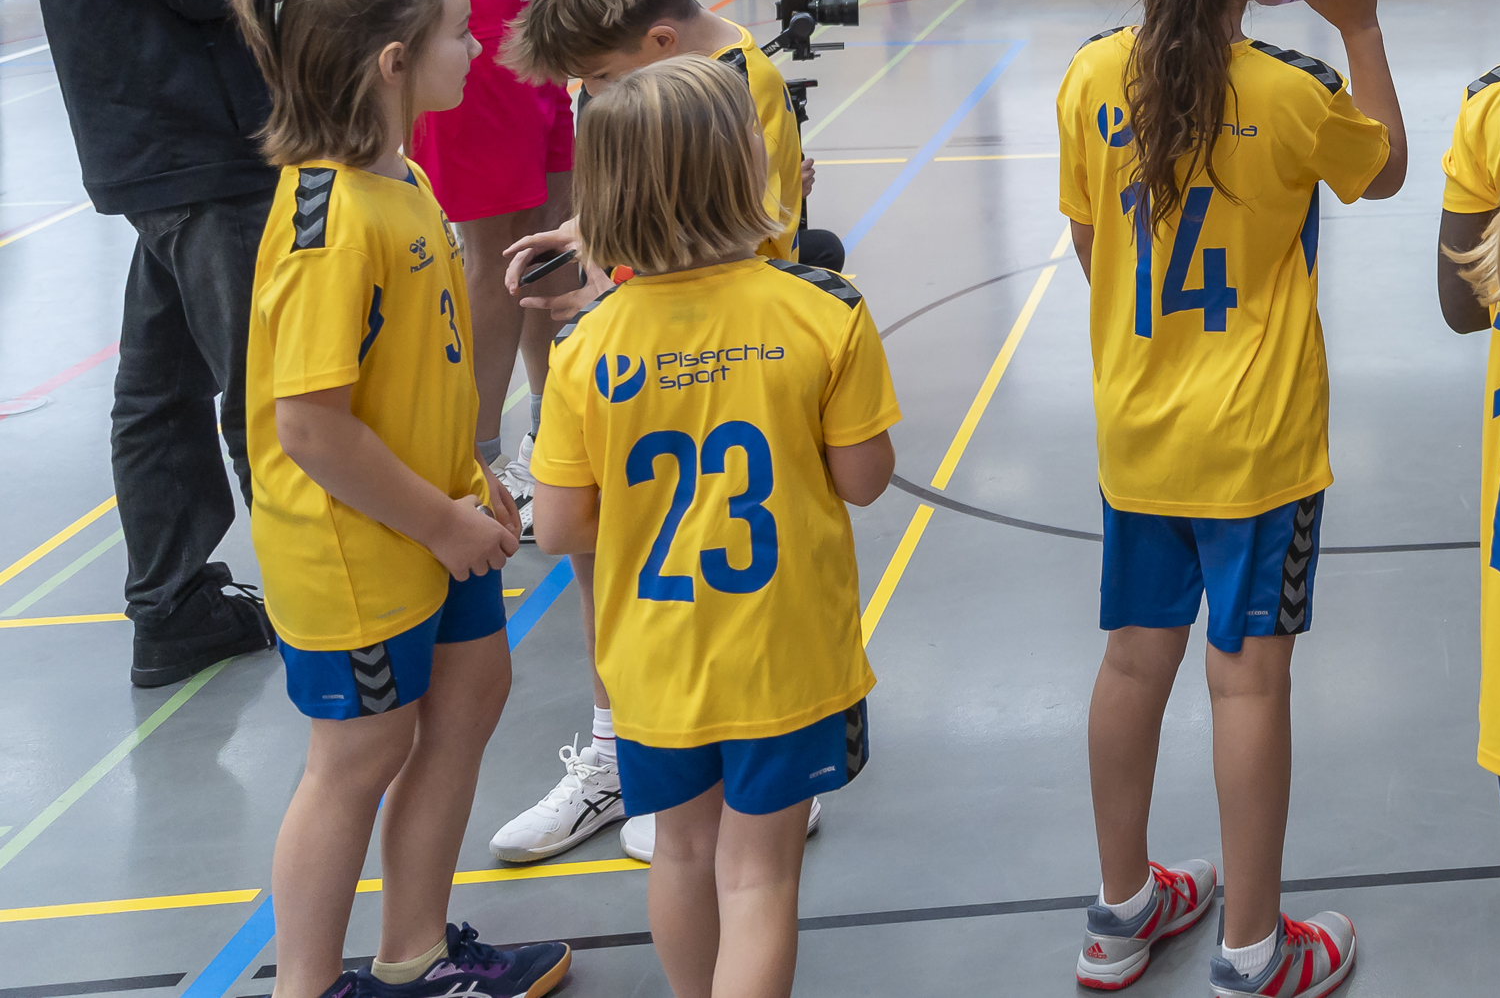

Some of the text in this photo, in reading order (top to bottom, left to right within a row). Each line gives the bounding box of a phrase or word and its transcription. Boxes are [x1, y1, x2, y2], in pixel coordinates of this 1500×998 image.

[1120, 182, 1238, 339] 14
[440, 288, 462, 364] 3
[656, 343, 785, 371] Piserchia
[658, 364, 731, 390] sport
[625, 420, 779, 603] 23
